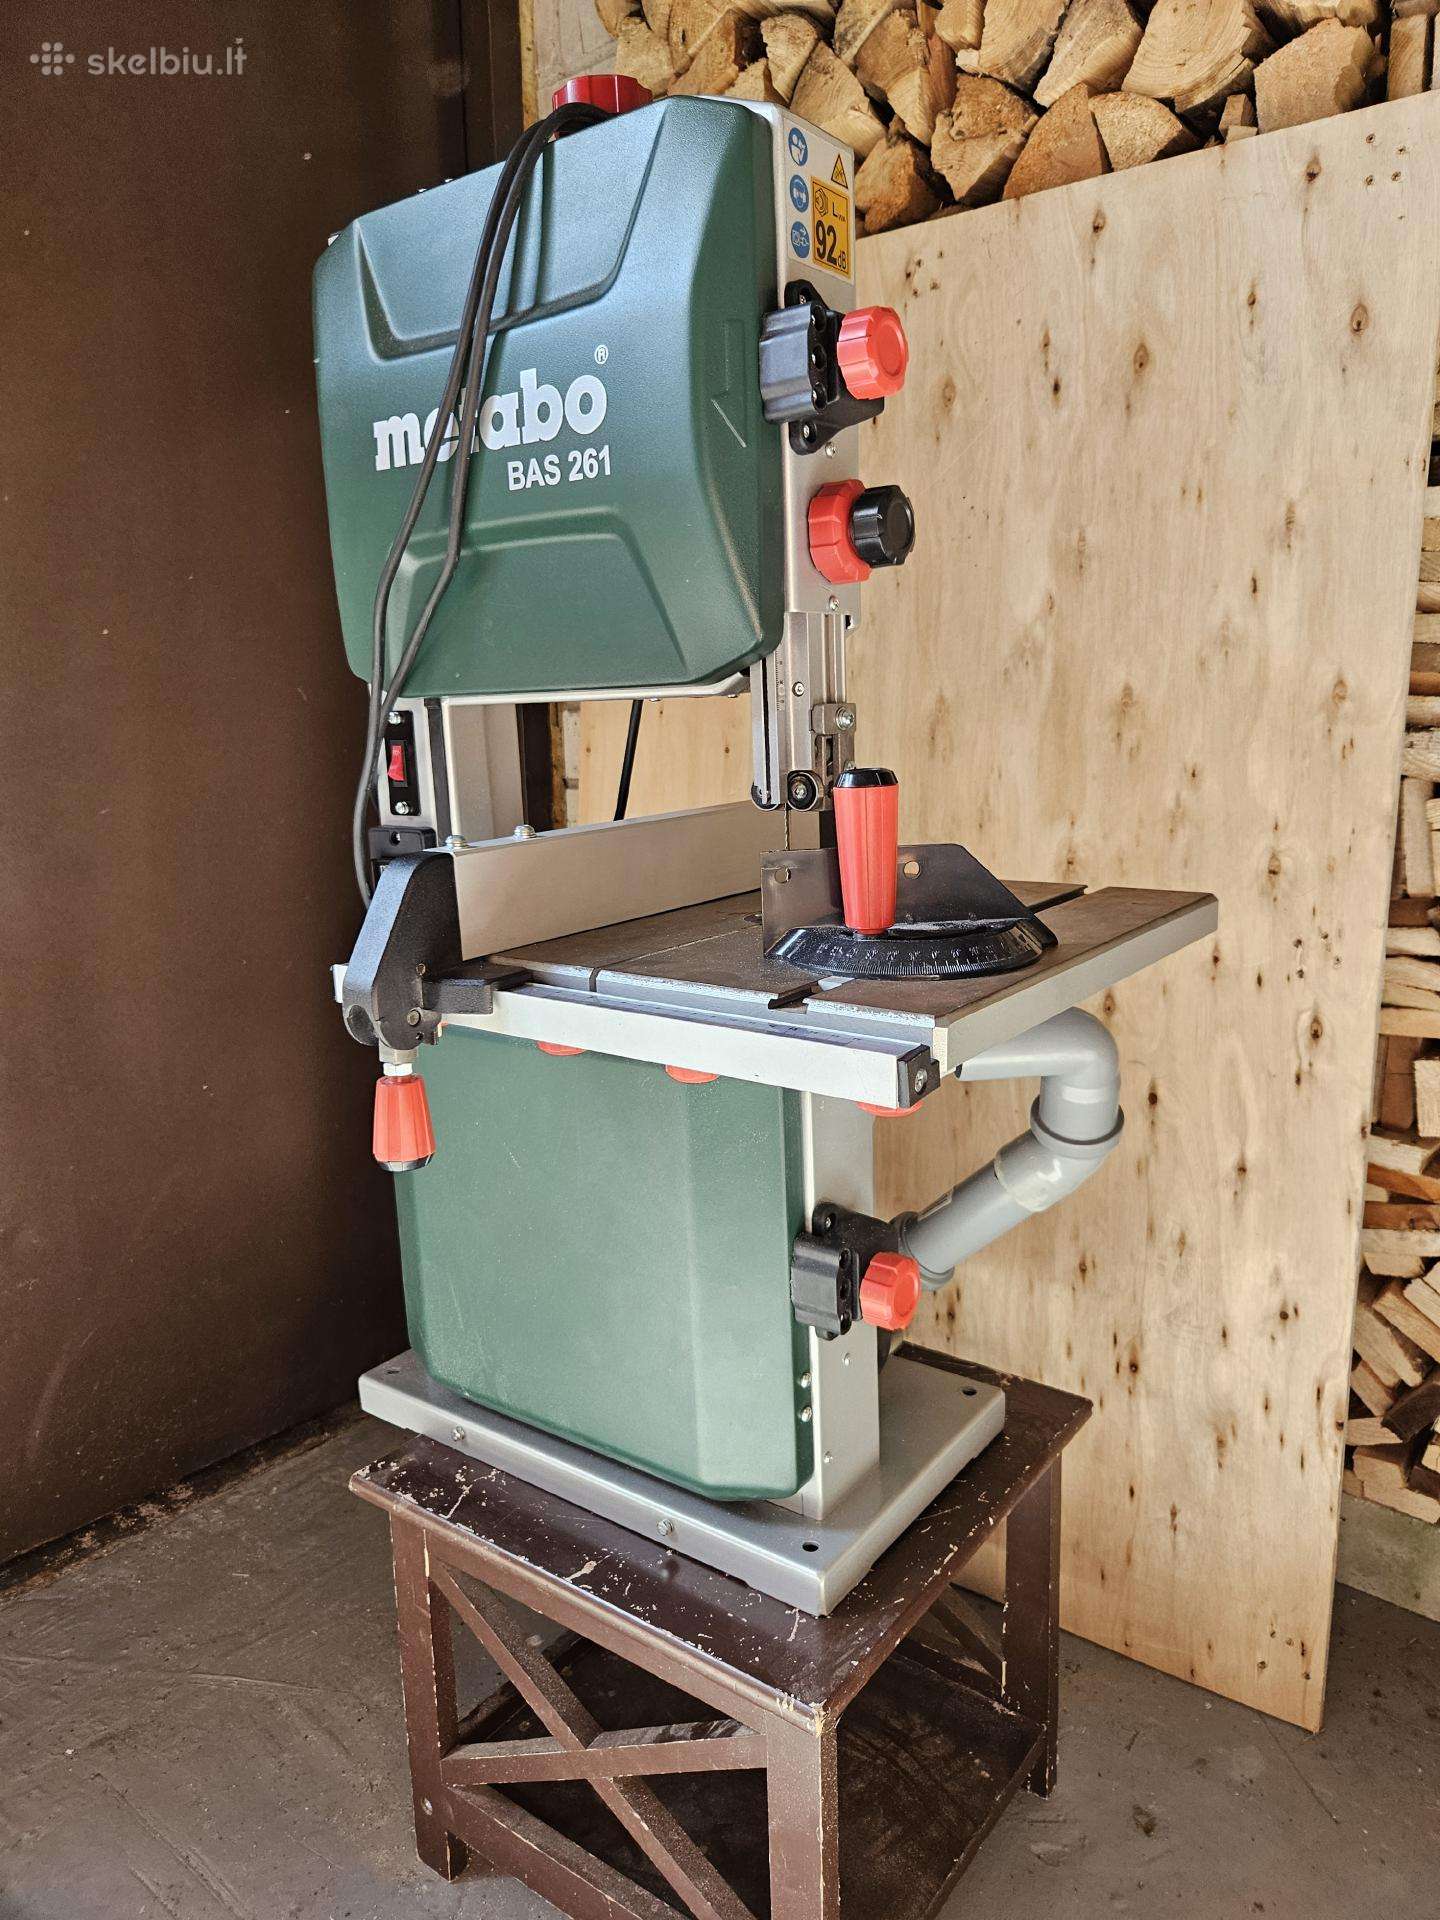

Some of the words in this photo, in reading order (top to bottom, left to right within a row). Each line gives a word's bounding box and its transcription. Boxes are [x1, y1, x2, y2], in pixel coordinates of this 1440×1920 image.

[815, 219, 838, 265] 92
[506, 454, 562, 491] BAS
[567, 444, 612, 482] 261
